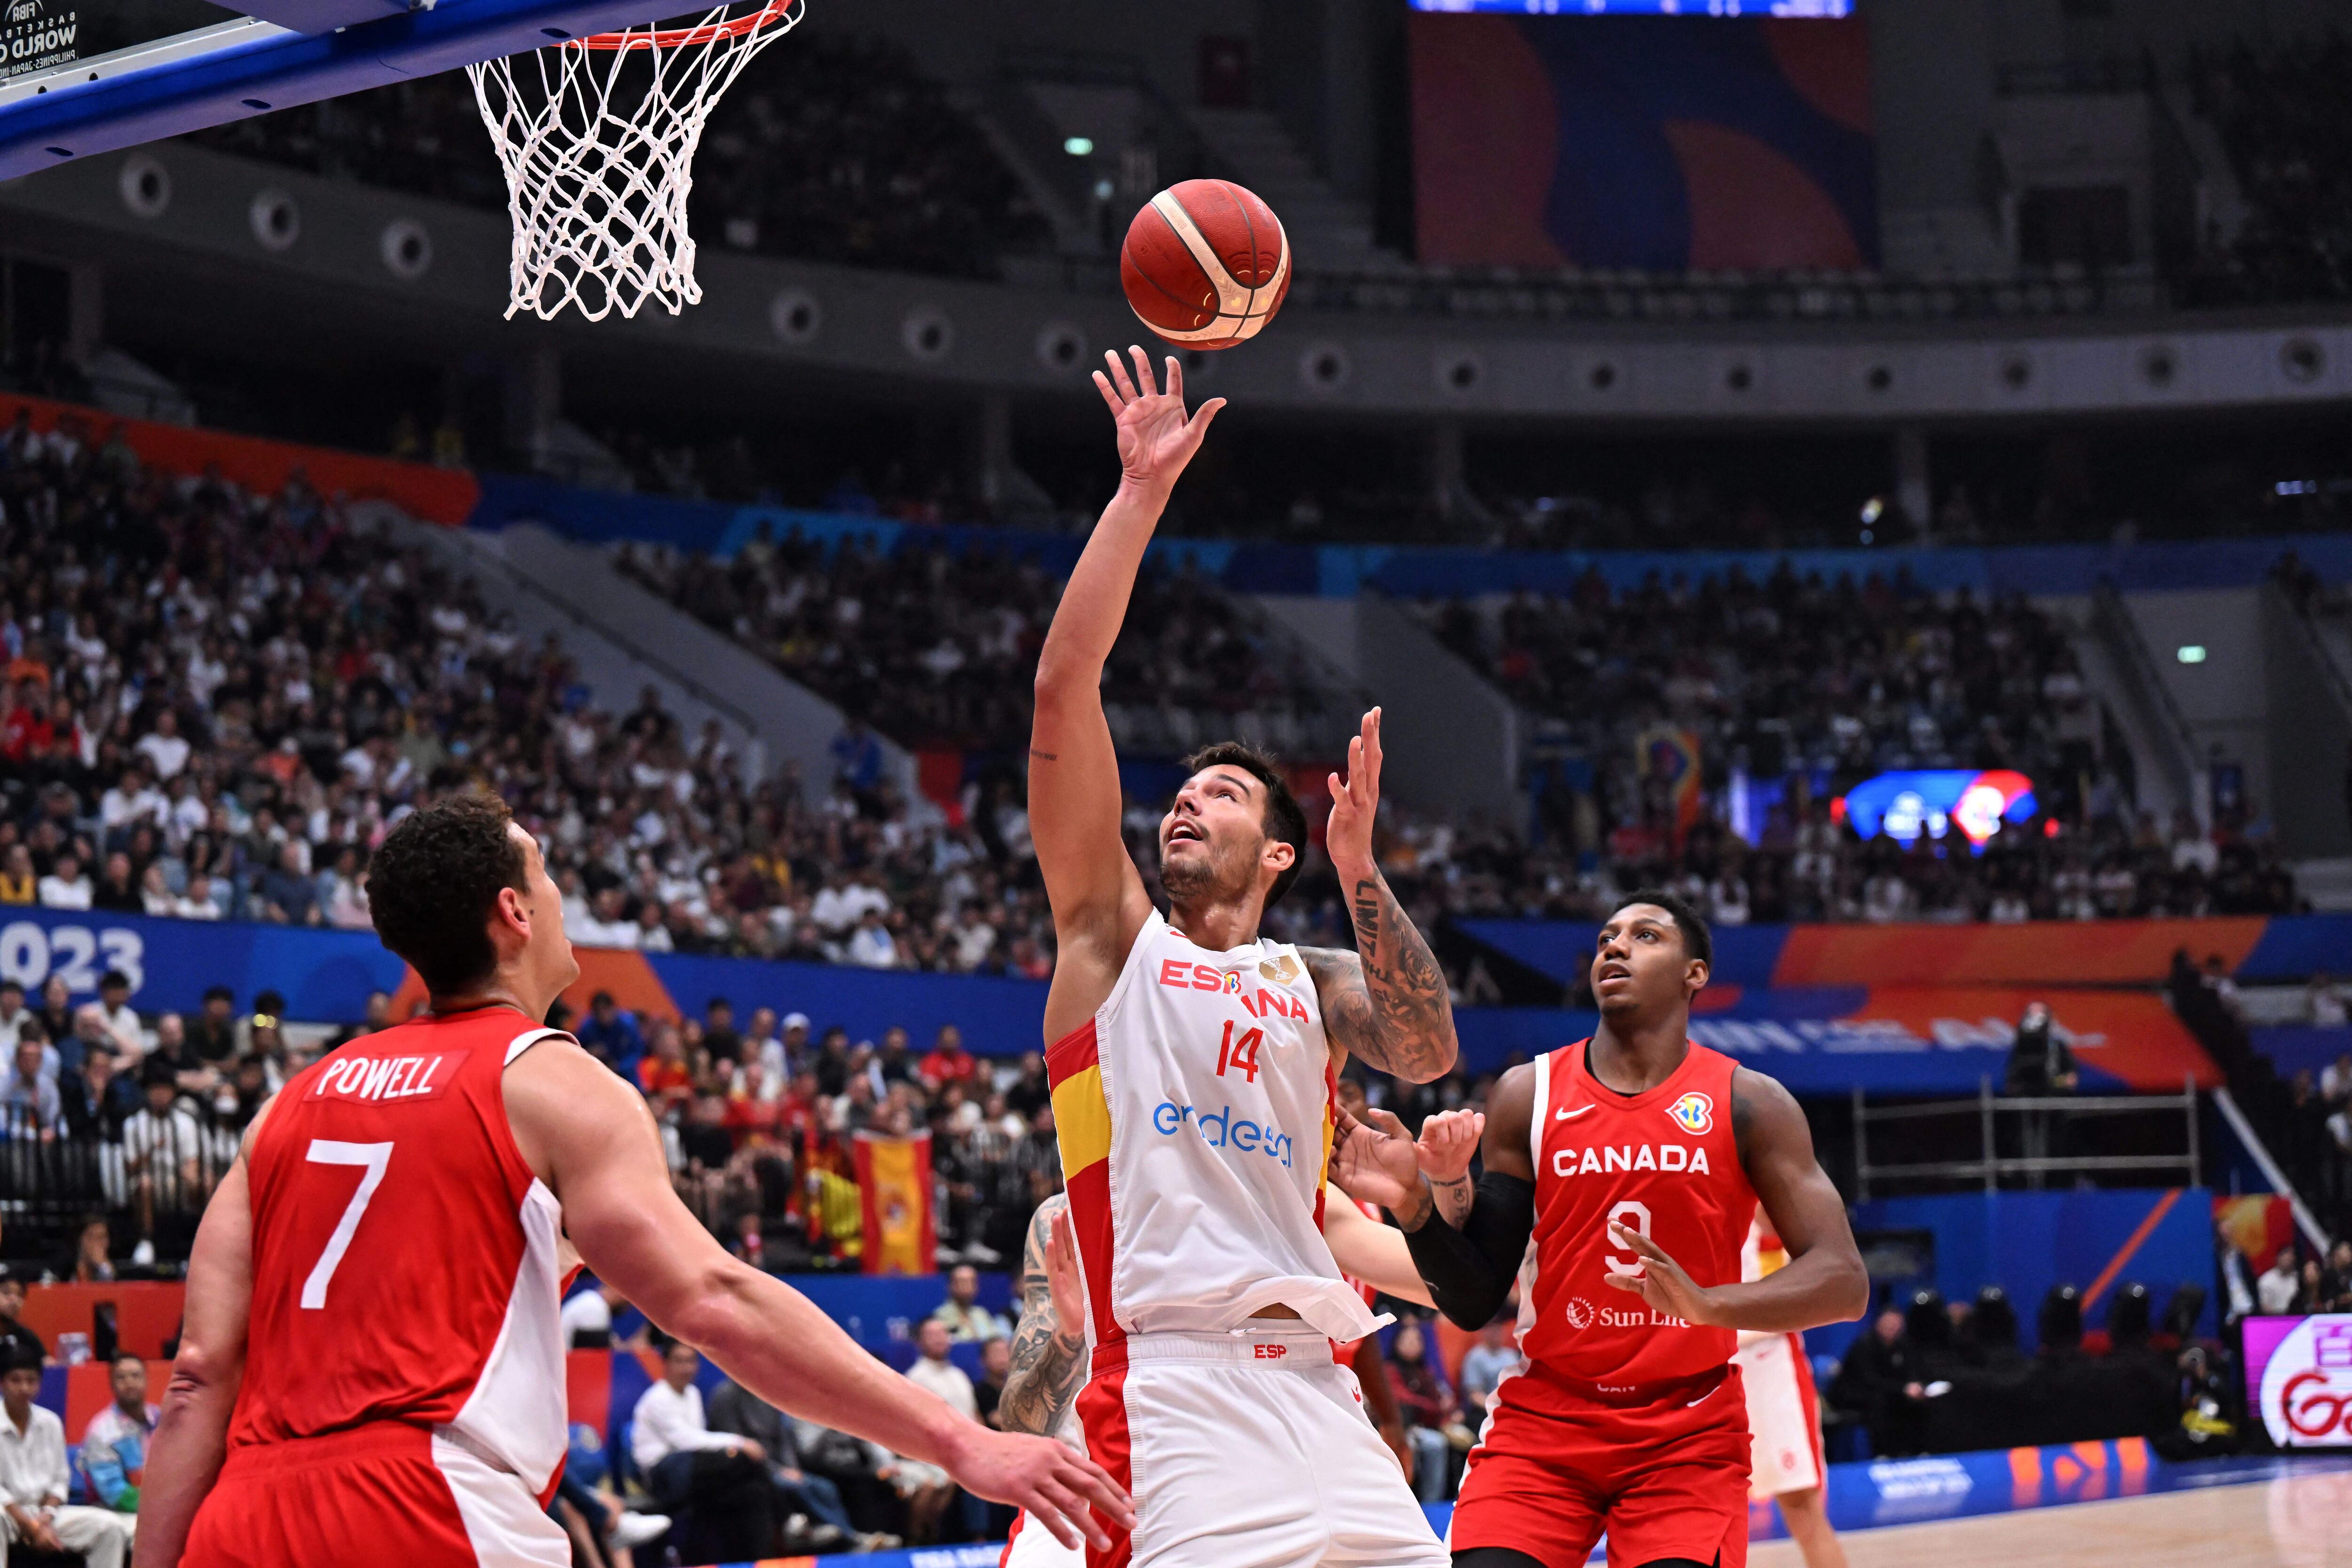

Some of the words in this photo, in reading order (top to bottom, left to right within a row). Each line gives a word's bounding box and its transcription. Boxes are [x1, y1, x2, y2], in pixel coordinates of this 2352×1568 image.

[1216, 1019, 1263, 1083] 14
[316, 1056, 443, 1100] POWELL
[1553, 1144, 1710, 1177] CANADA
[300, 1139, 395, 1309] 7
[1605, 1201, 1651, 1276] 9
[1599, 1307, 1645, 1327] Sun
[1254, 1345, 1287, 1358] ESP
